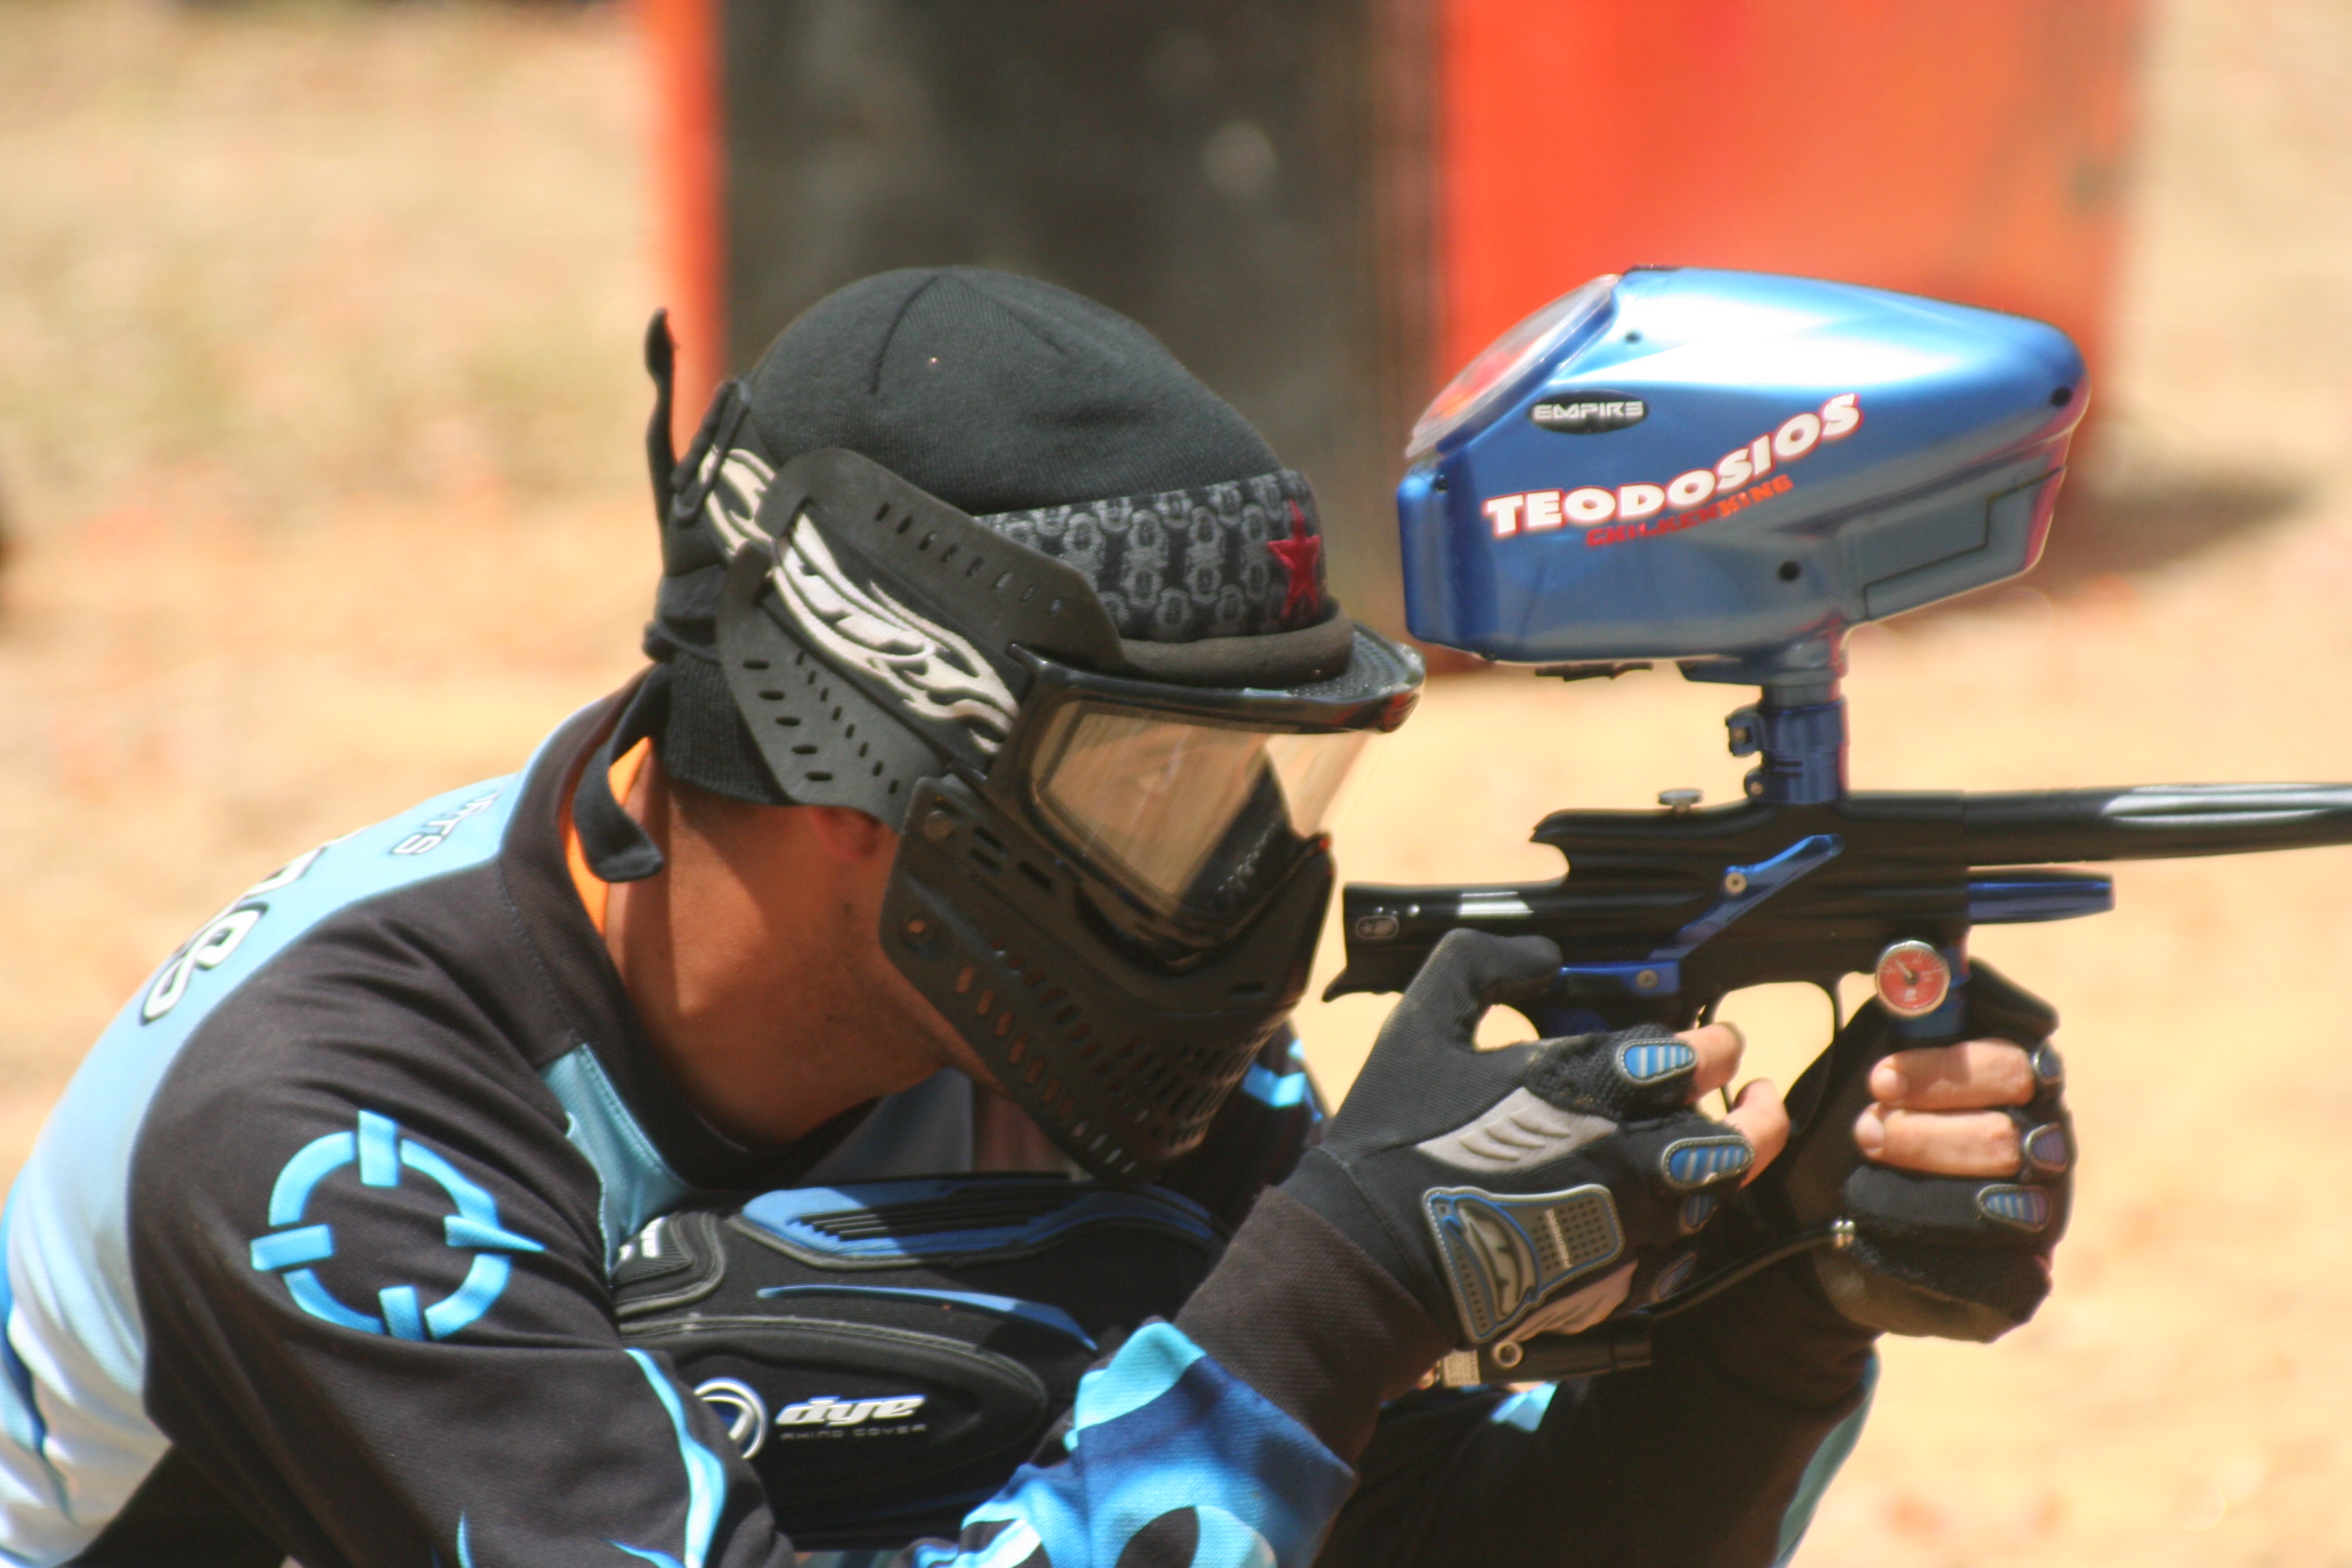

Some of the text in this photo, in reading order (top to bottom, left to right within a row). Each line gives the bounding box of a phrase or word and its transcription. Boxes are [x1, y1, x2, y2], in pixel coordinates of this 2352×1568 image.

[1533, 400, 1644, 421] EMPIRE
[1484, 393, 1862, 538] TEODOSIOS
[775, 1394, 926, 1428] dye
[781, 1424, 927, 1440] RHINO COVER
